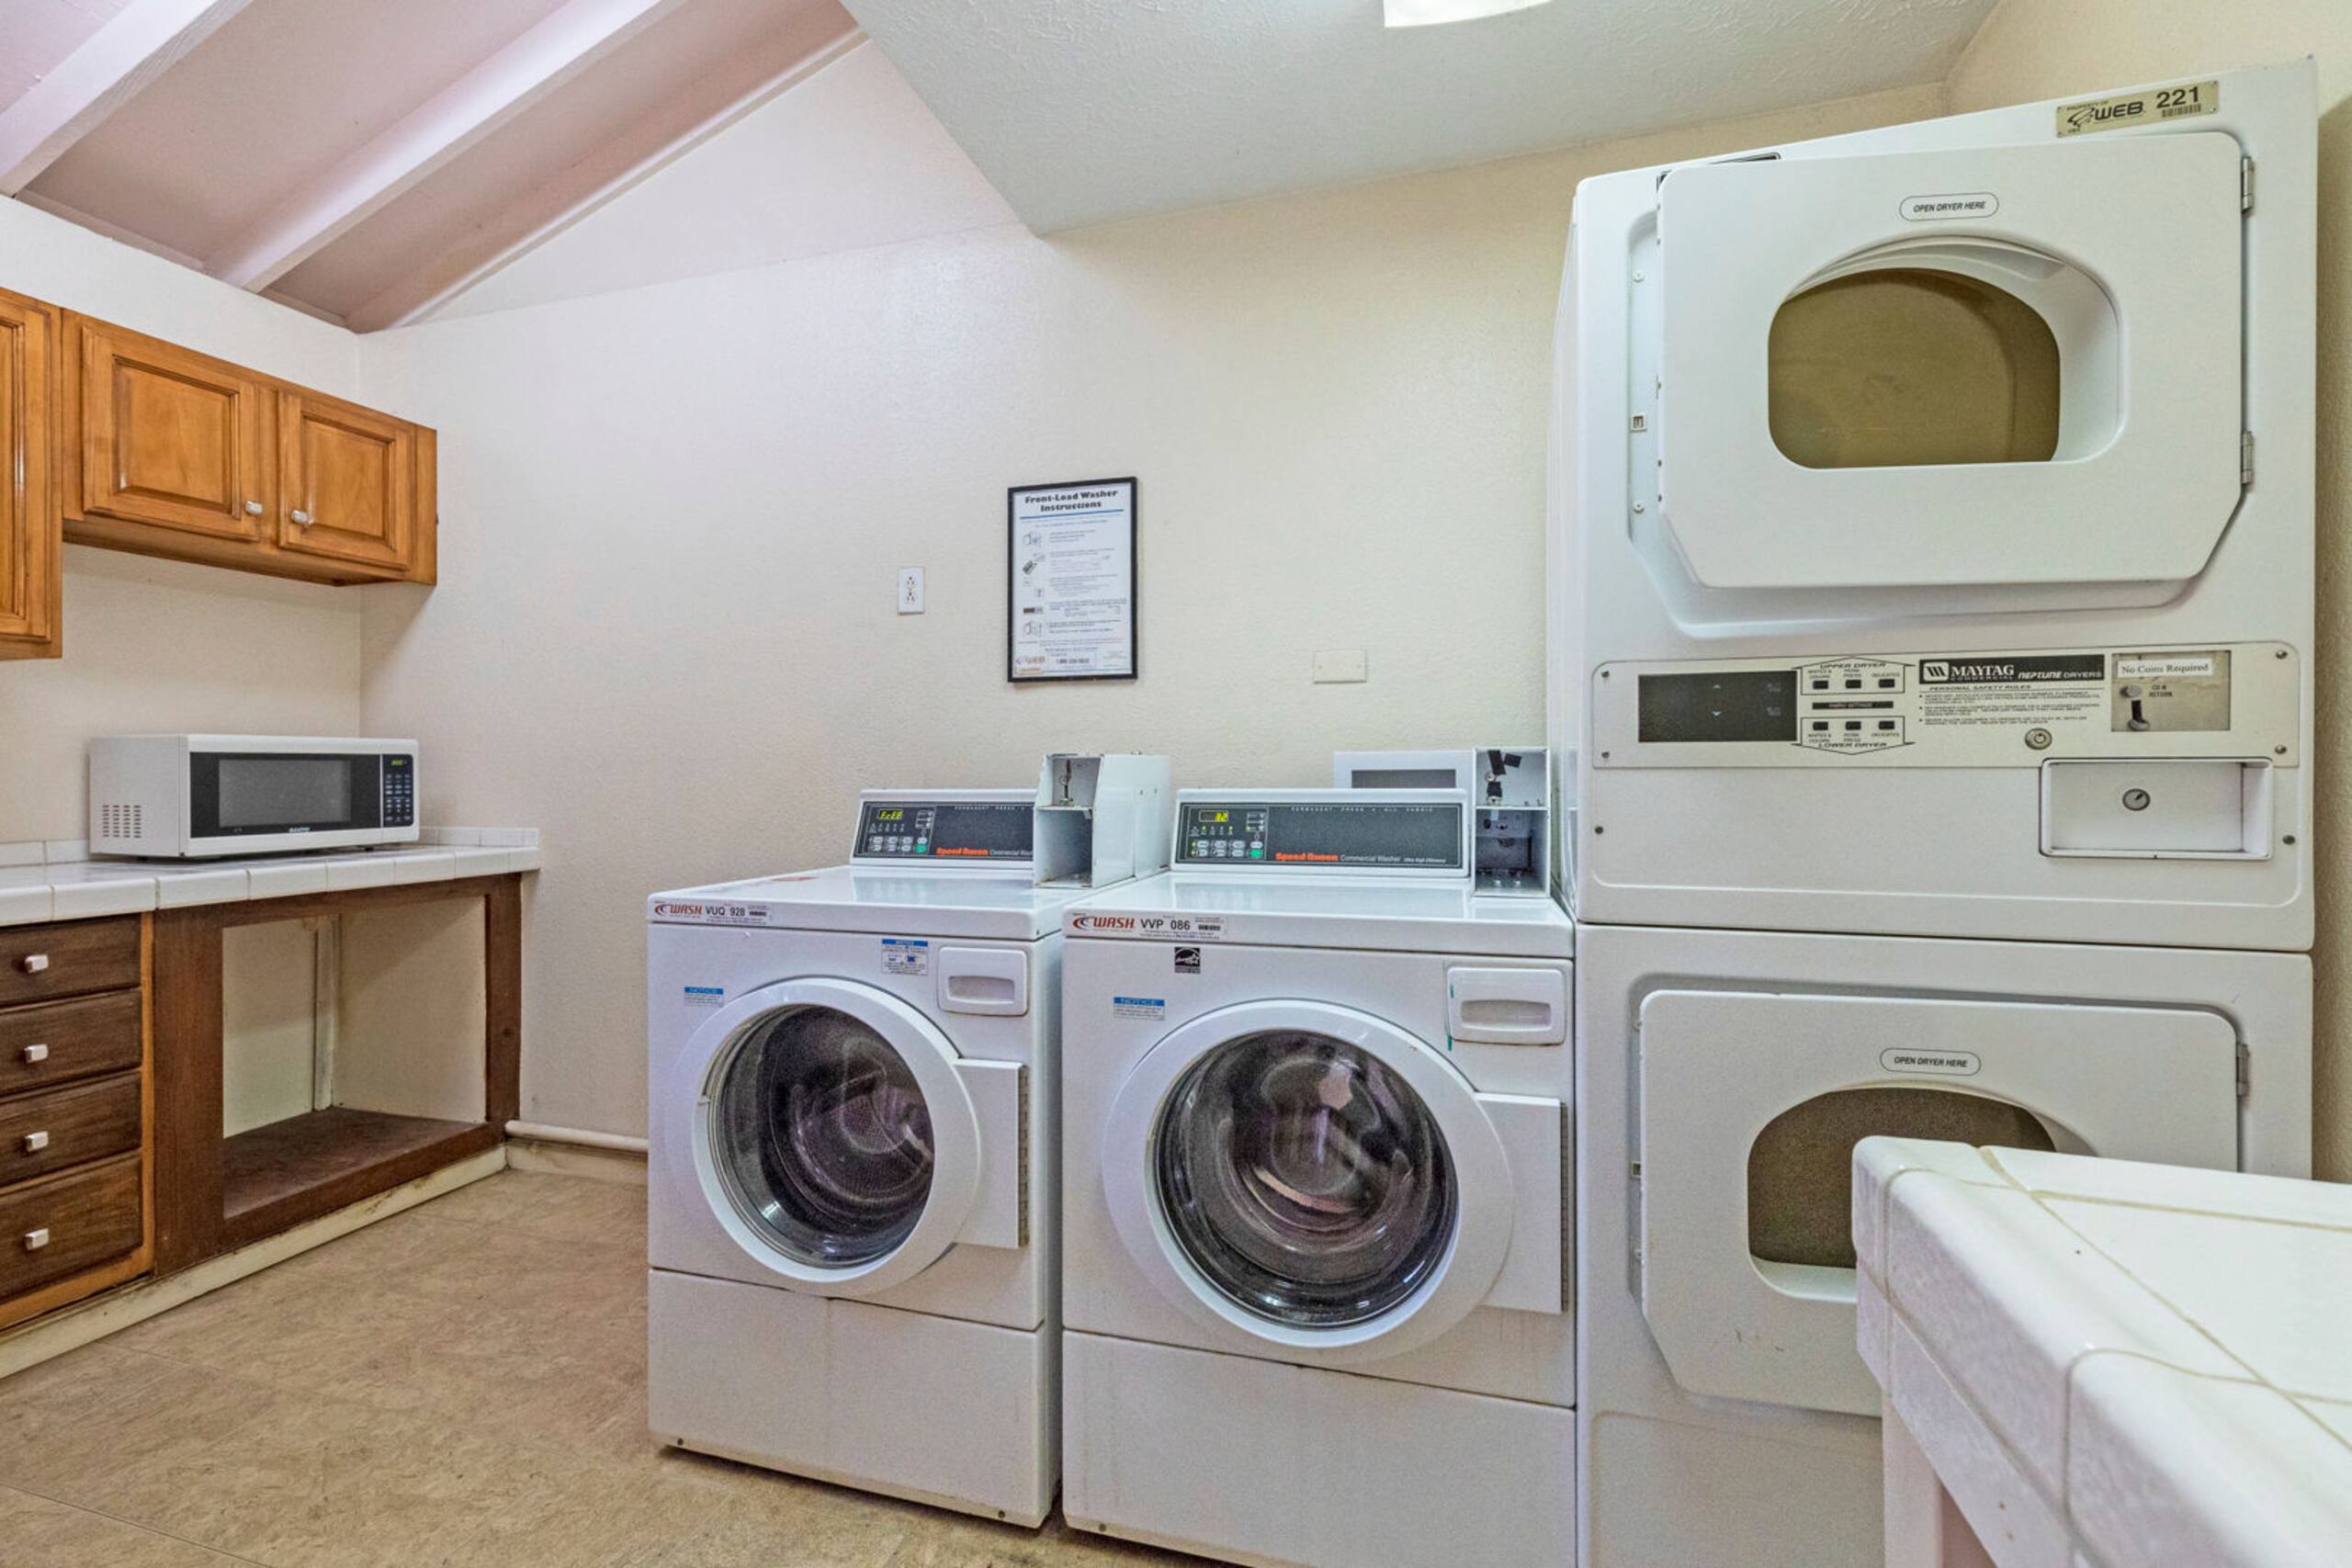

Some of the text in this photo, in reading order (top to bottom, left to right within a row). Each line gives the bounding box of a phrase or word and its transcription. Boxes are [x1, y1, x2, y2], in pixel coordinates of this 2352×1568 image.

[2067, 102, 2099, 111] PROPERTY
[2094, 85, 2199, 120] WEB 221
[1913, 201, 1985, 212] OPEN DRYER HERE
[1024, 490, 1118, 503] Front-Load Washer
[1040, 501, 1102, 513] Instructions
[1951, 664, 2014, 677] MAYTAG
[2121, 663, 2209, 674] No Coins Required
[2018, 671, 2102, 680] NEPTUNE DRYERS
[937, 846, 962, 856] Speed
[1275, 852, 1306, 862] Speed
[1307, 852, 1339, 861] Queen
[670, 903, 703, 916] WASH
[706, 906, 726, 917] VUQ
[729, 907, 745, 917] 928
[1092, 917, 1136, 929] WASH
[1140, 919, 1164, 929] VVP
[1170, 919, 1191, 931] 086
[1894, 1056, 1967, 1067] OPEN DRYER HERE
